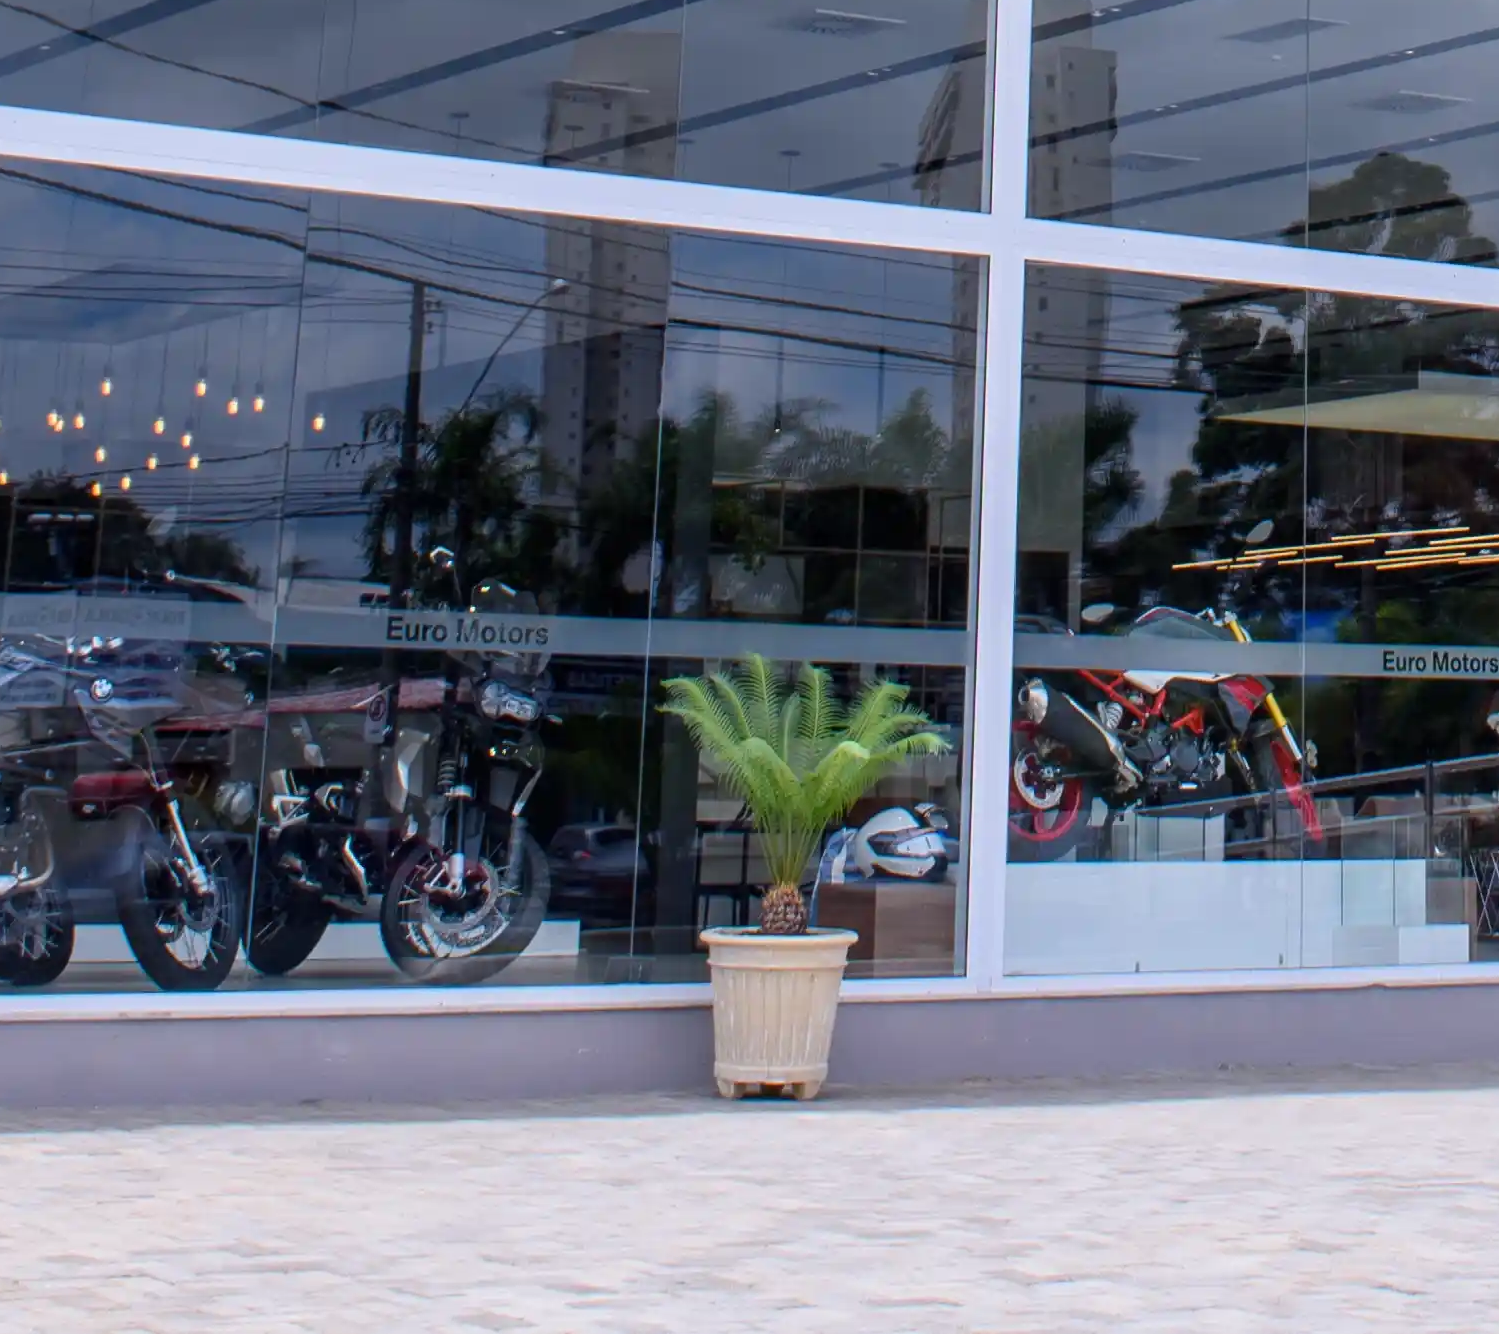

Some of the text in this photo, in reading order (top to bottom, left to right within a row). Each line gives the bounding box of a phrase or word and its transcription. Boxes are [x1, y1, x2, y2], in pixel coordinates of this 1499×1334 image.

[386, 617, 549, 646] Euro Motors
[1383, 650, 1499, 674] Euro Motors
